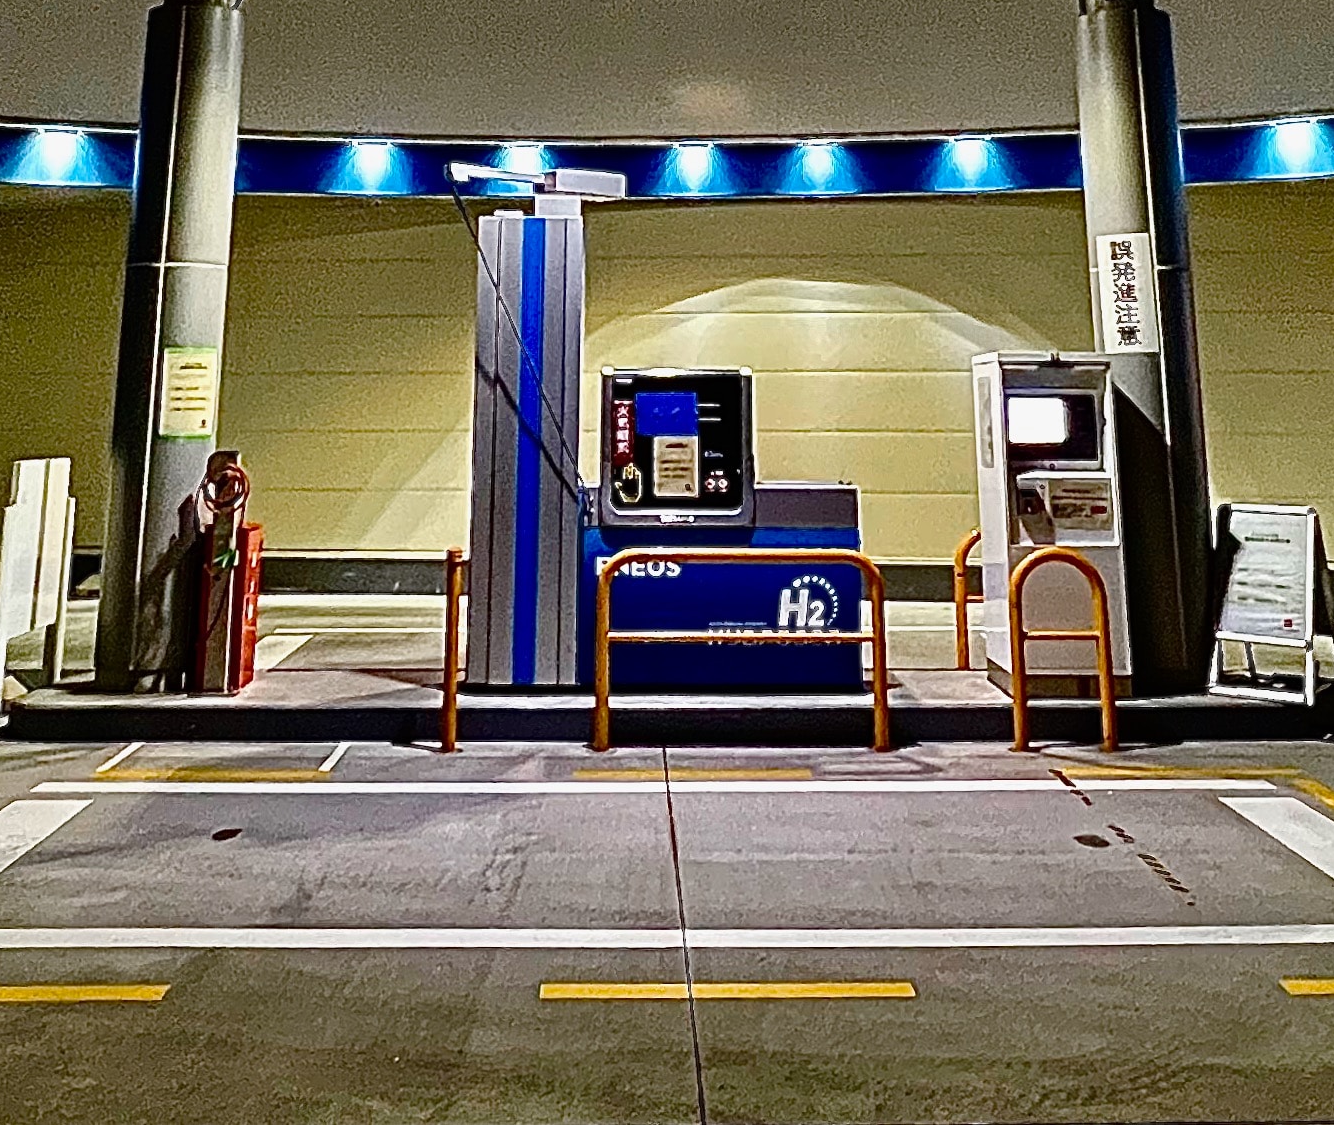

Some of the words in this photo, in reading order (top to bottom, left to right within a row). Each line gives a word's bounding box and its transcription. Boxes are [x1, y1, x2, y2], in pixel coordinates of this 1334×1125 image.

[1109, 240, 1143, 347] 誤発進注意
